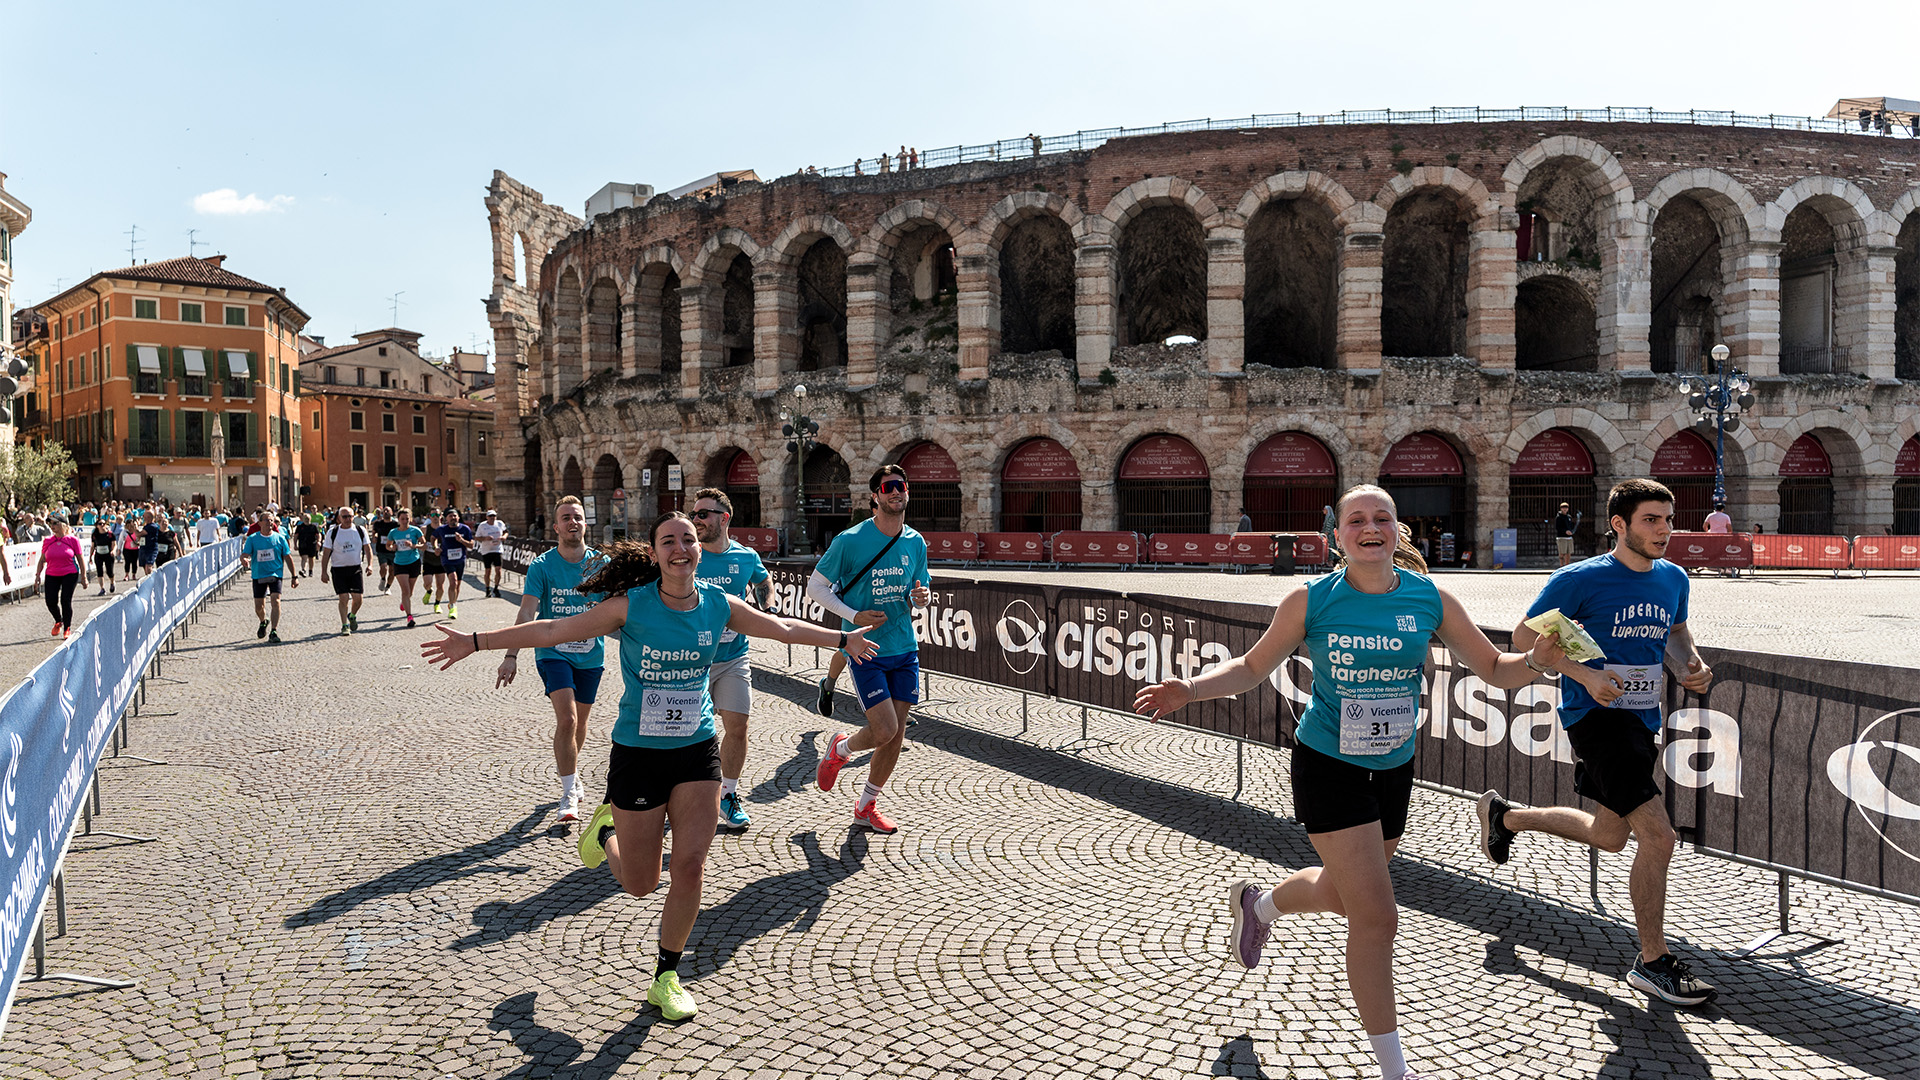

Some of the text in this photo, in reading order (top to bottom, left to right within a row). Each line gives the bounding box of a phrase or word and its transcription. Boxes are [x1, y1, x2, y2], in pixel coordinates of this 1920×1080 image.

[871, 566, 904, 577] Pensito
[871, 578, 885, 586] de
[551, 587, 582, 596] Pensi
[551, 596, 565, 604] de
[773, 580, 826, 623] salfa
[1096, 607, 1196, 635] SPORT
[1614, 602, 1671, 627] LIBERTAS
[911, 605, 977, 652] alfa
[1327, 633, 1403, 651] Pensito
[641, 644, 700, 661] Pensito
[1328, 649, 1355, 665] de
[641, 659, 662, 670] de
[1623, 680, 1655, 691] 2321
[666, 697, 700, 705] Vicentini
[1627, 698, 1655, 706] Vicentini
[665, 709, 682, 720] 32
[1370, 704, 1411, 717] Vicentini
[1370, 721, 1390, 735] 31
[0, 829, 46, 986] ORCHIMICA
